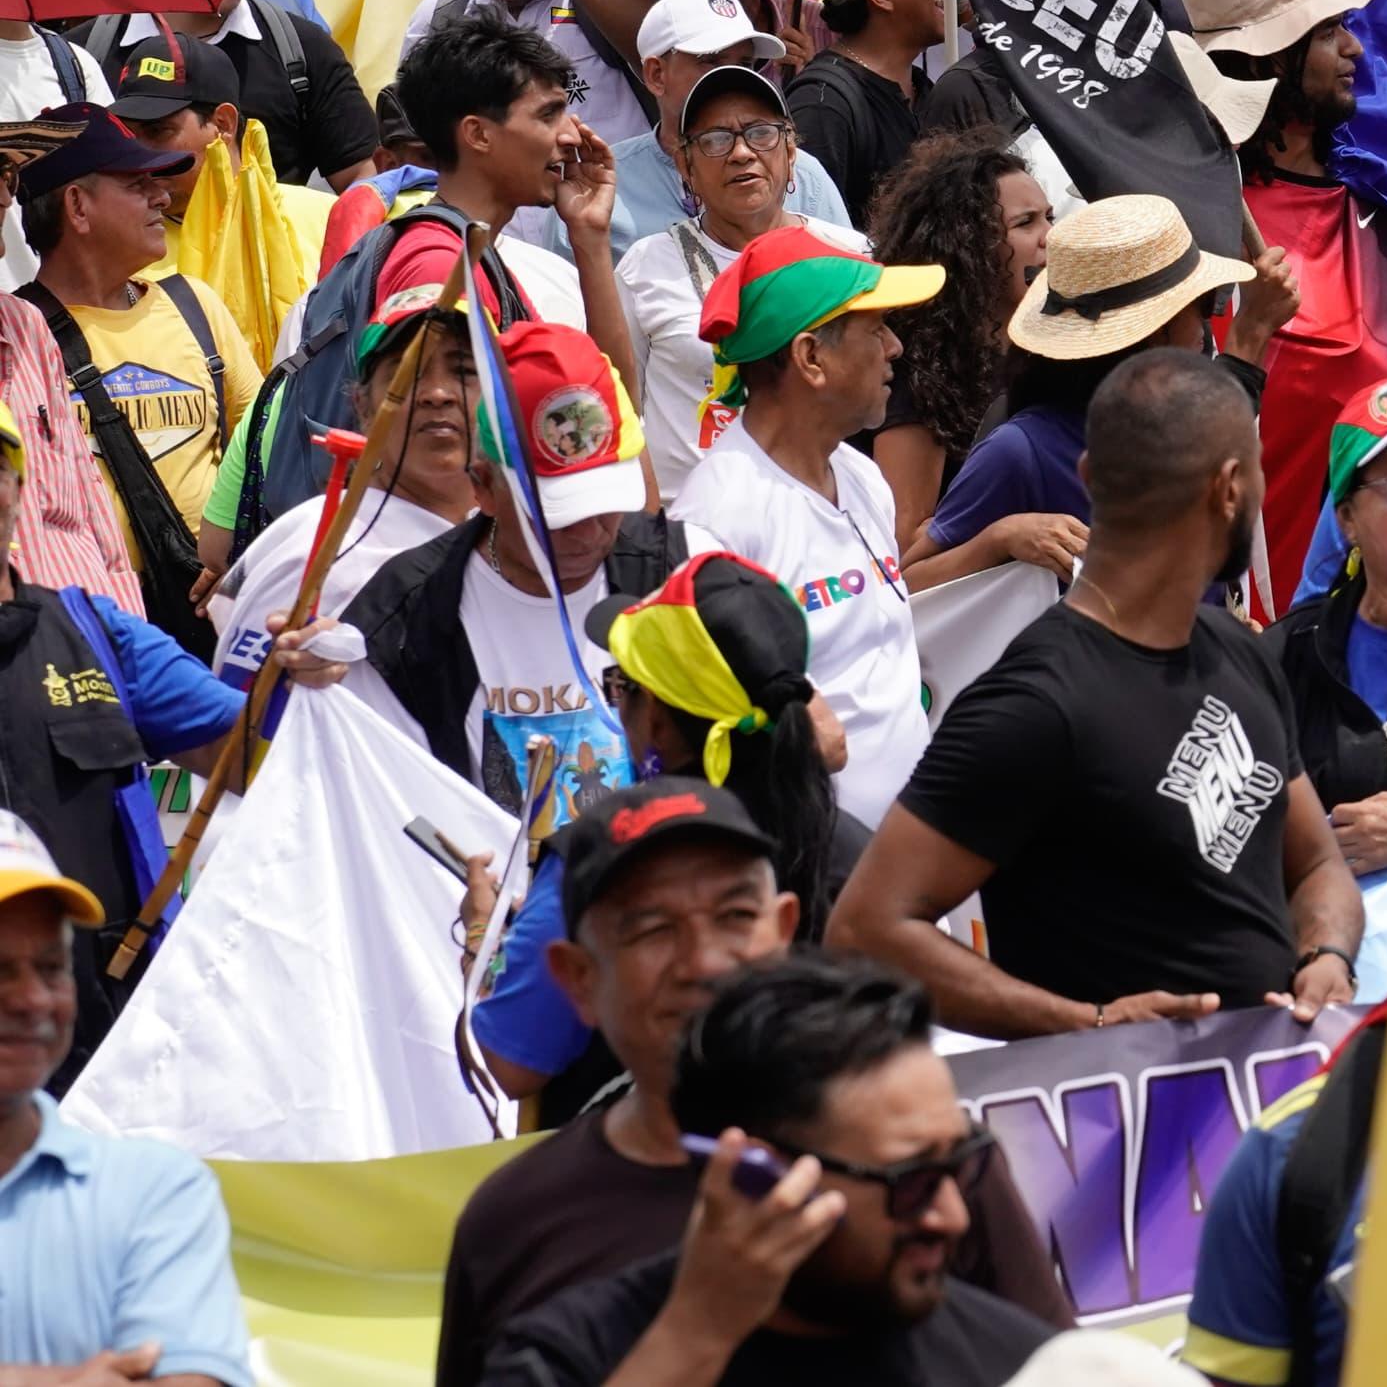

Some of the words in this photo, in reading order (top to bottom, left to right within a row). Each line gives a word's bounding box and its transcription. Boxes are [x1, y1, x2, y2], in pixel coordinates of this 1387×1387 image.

[146, 61, 171, 76] UP
[1020, 44, 1110, 110] 1998
[134, 378, 172, 391] COWBOYS
[157, 394, 203, 427] MENS
[1156, 694, 1232, 804] MENU
[1187, 712, 1255, 855] MENU
[1203, 760, 1284, 874] MENU
